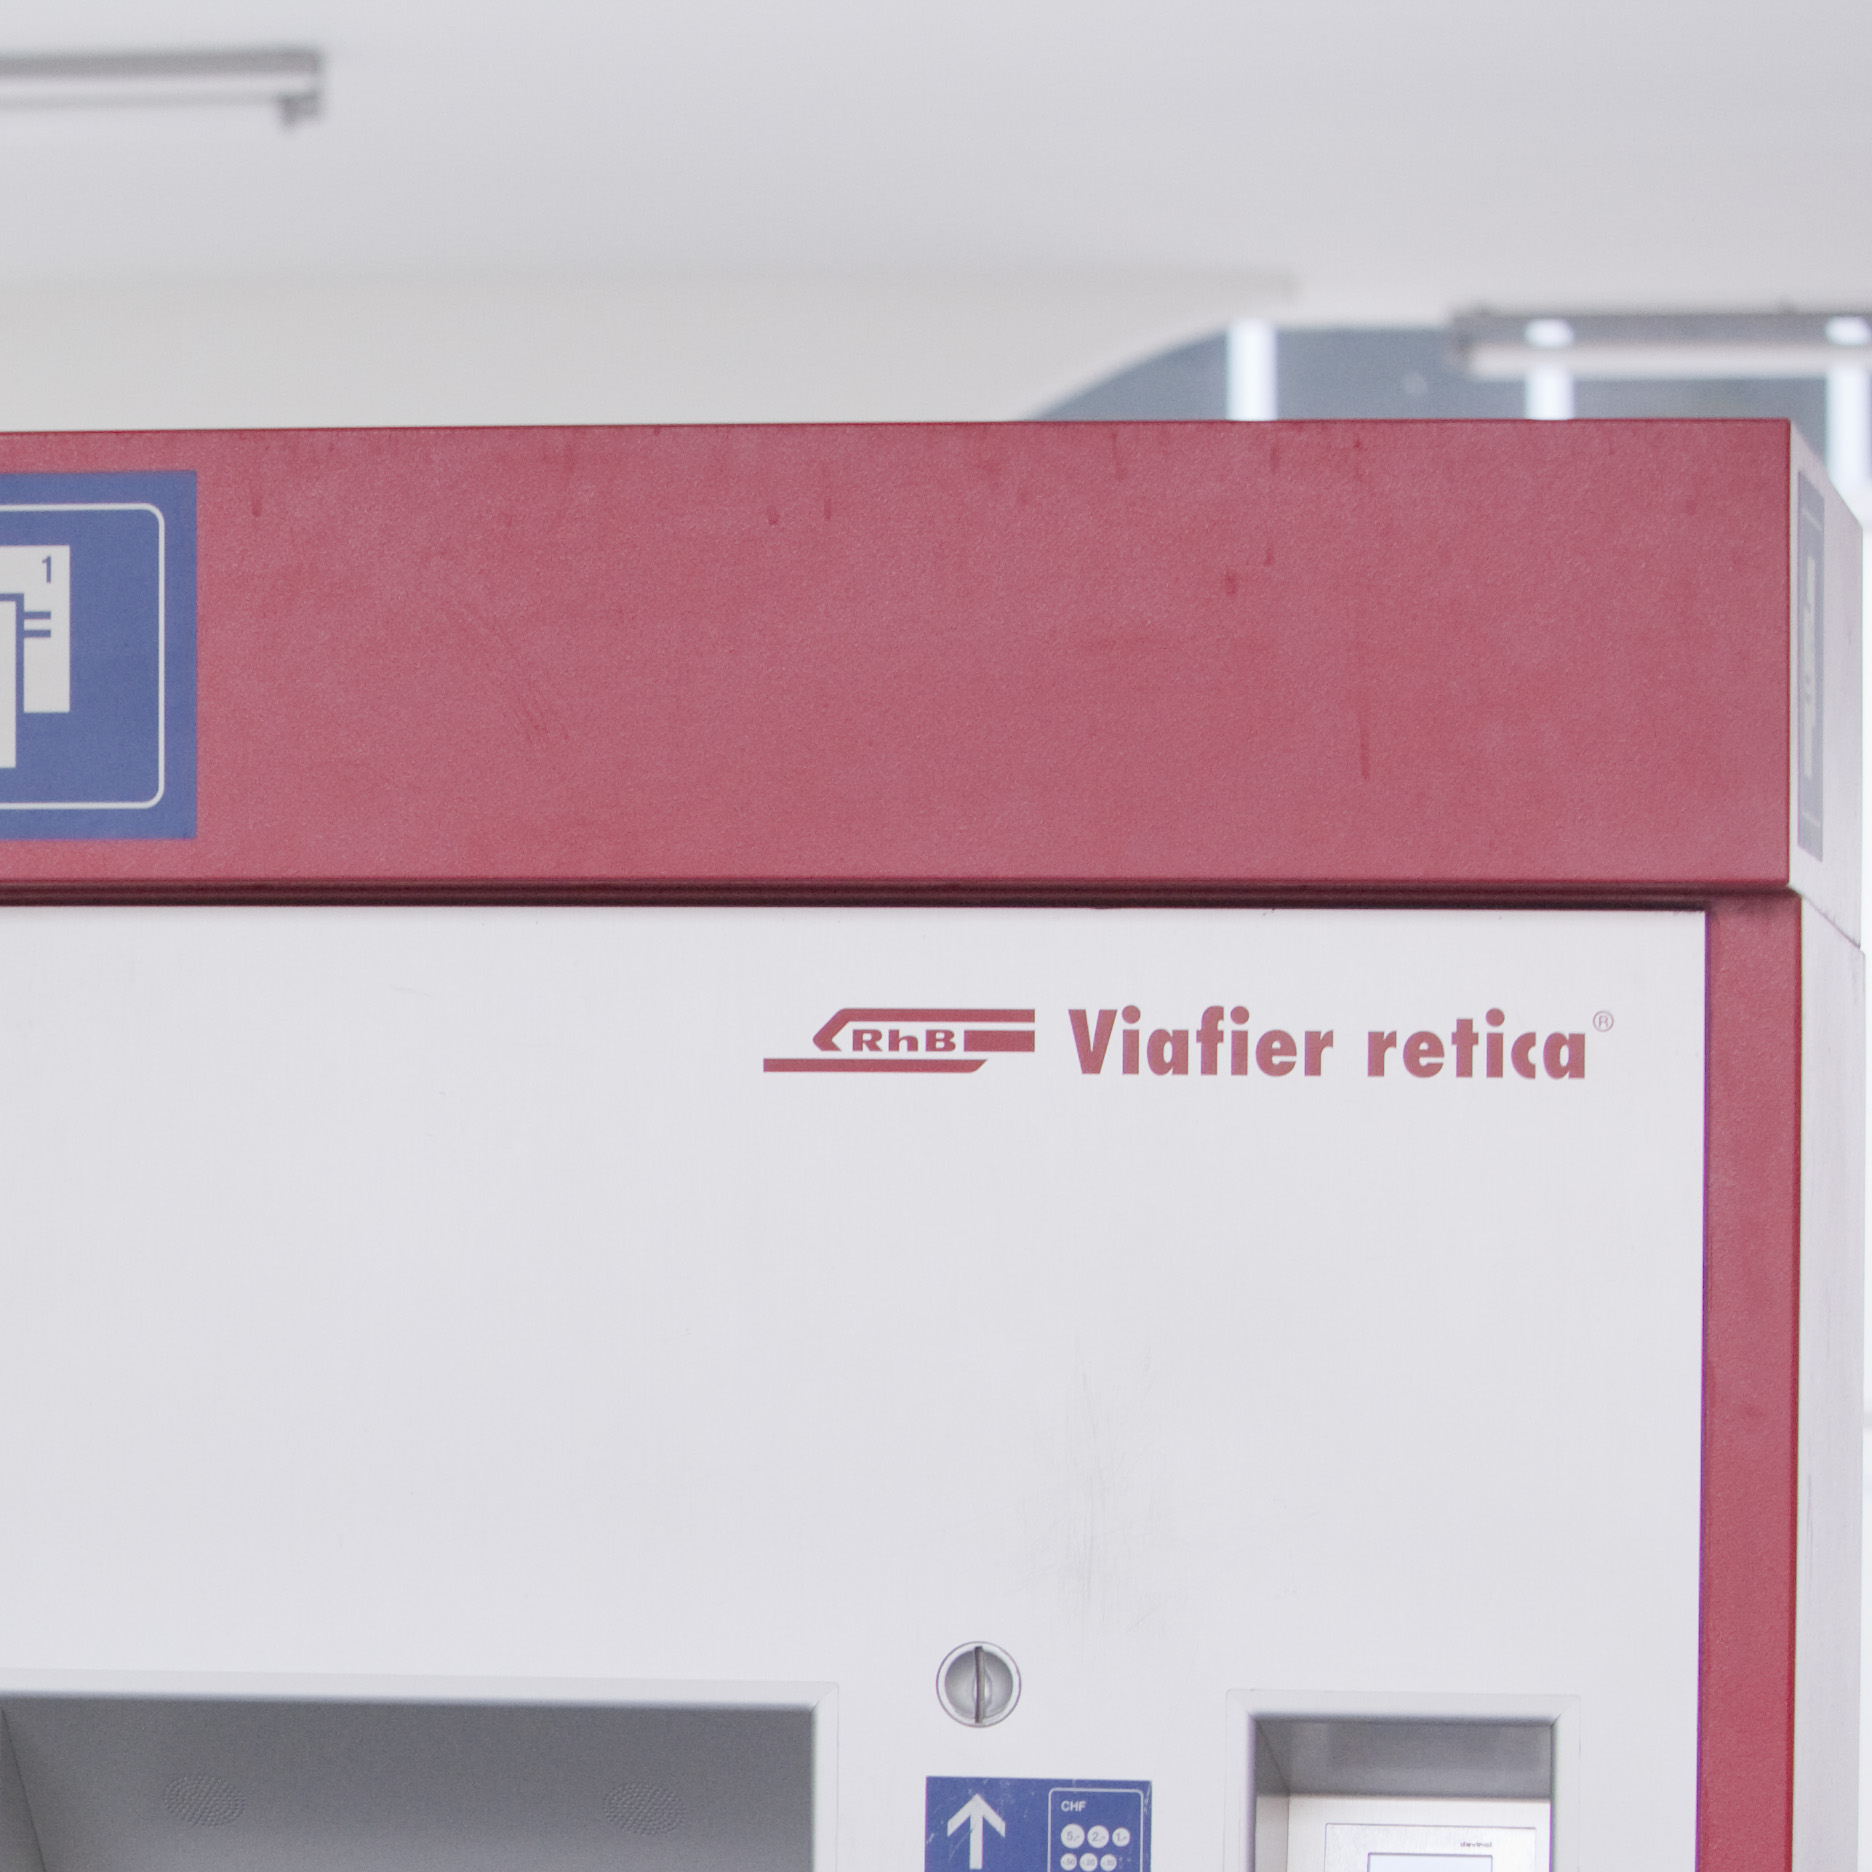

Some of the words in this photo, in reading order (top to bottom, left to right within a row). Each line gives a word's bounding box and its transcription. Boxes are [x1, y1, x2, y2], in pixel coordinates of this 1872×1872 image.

[41, 555, 55, 584] 1
[851, 1027, 958, 1053] RhB
[1067, 1004, 1335, 1078] Viafier
[1060, 1800, 1087, 1812] CHF
